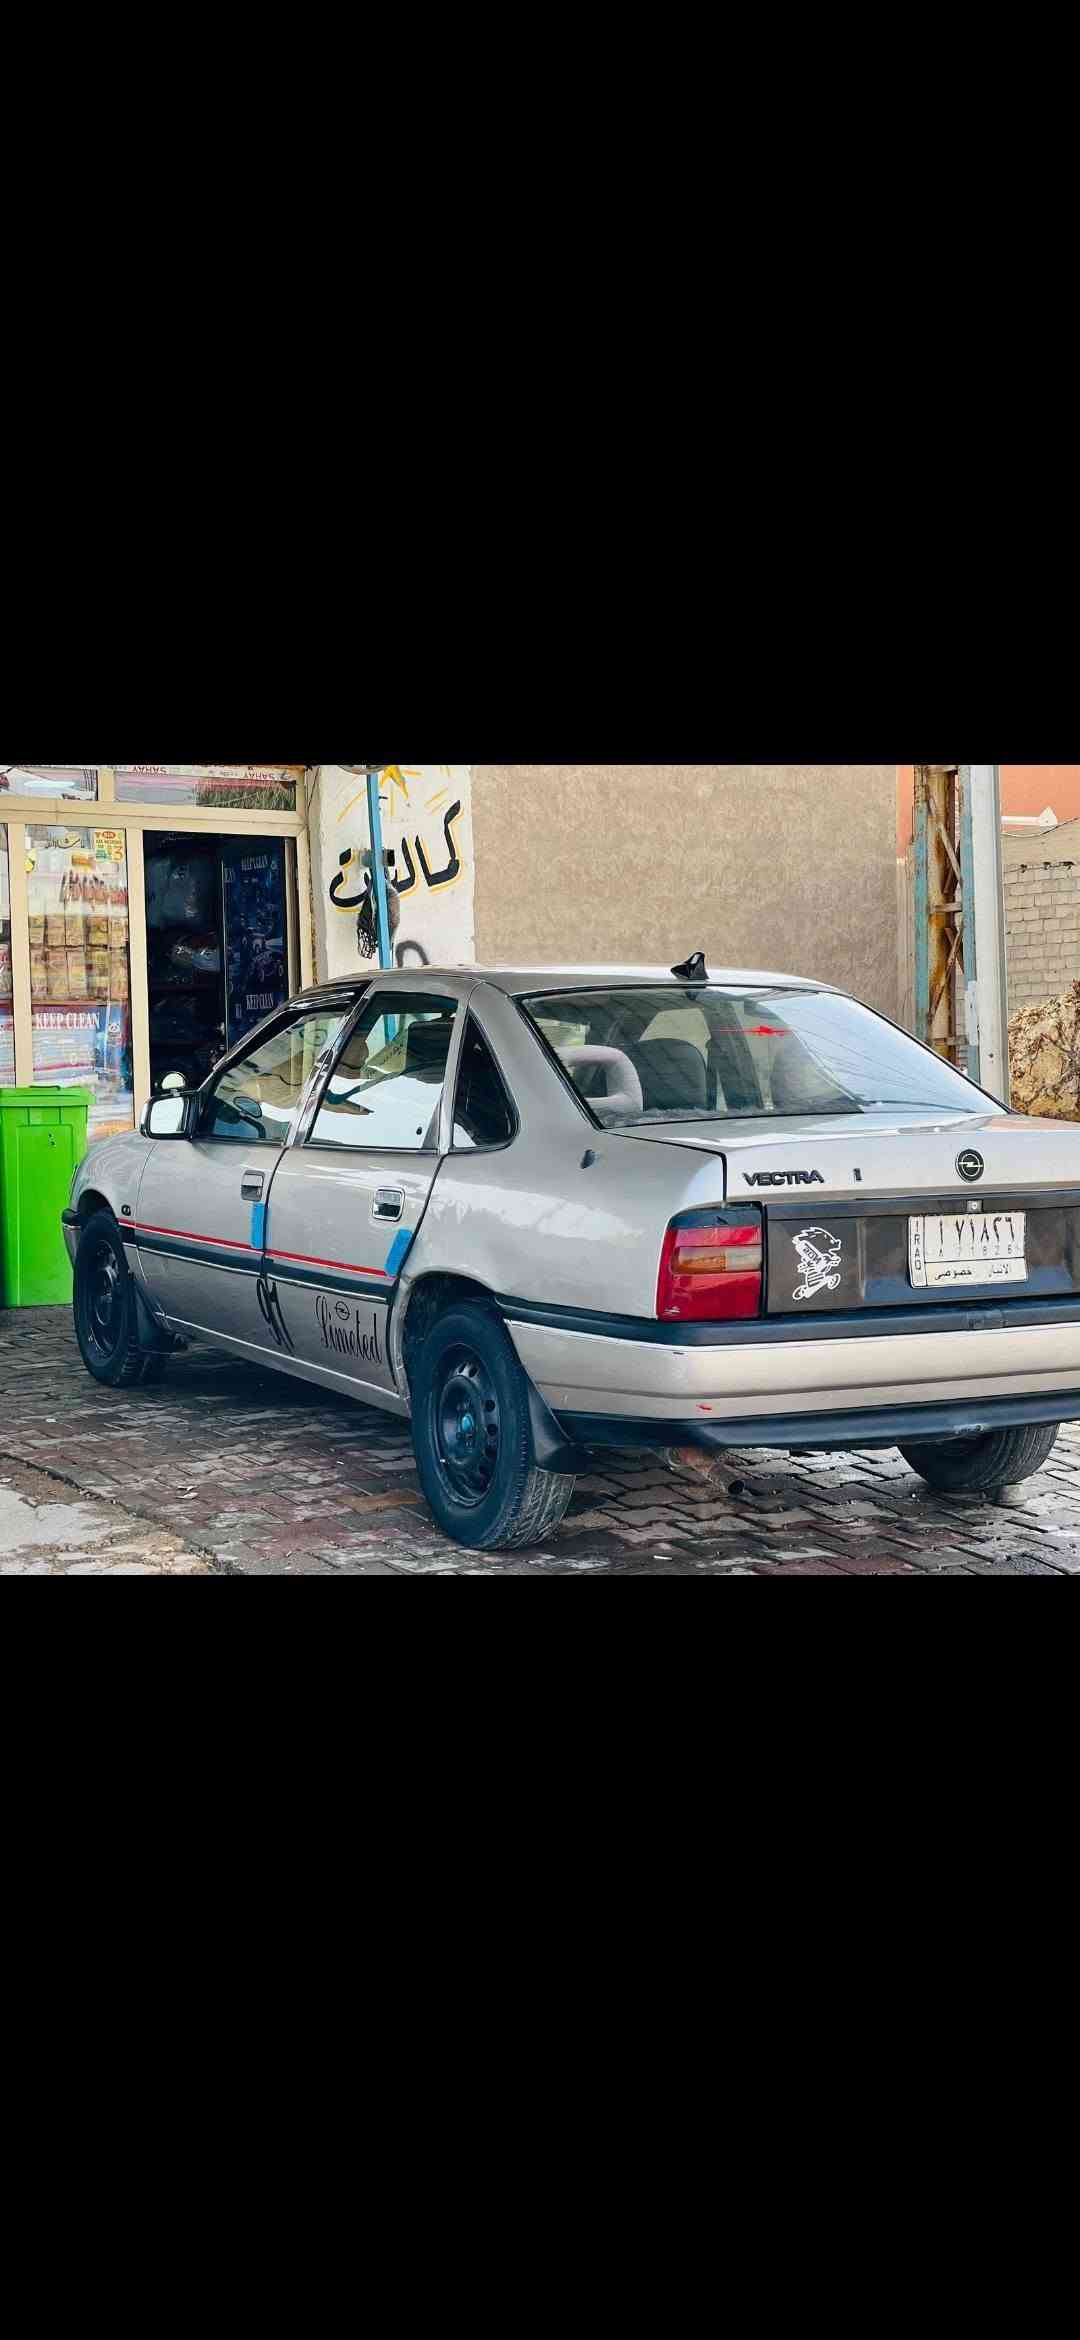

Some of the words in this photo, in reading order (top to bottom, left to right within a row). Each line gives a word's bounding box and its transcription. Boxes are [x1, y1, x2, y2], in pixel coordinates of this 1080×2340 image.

[35, 1012, 64, 1030] KEEP
[65, 1012, 100, 1029] CLEAN
[742, 1169, 825, 1187] VECTRA
